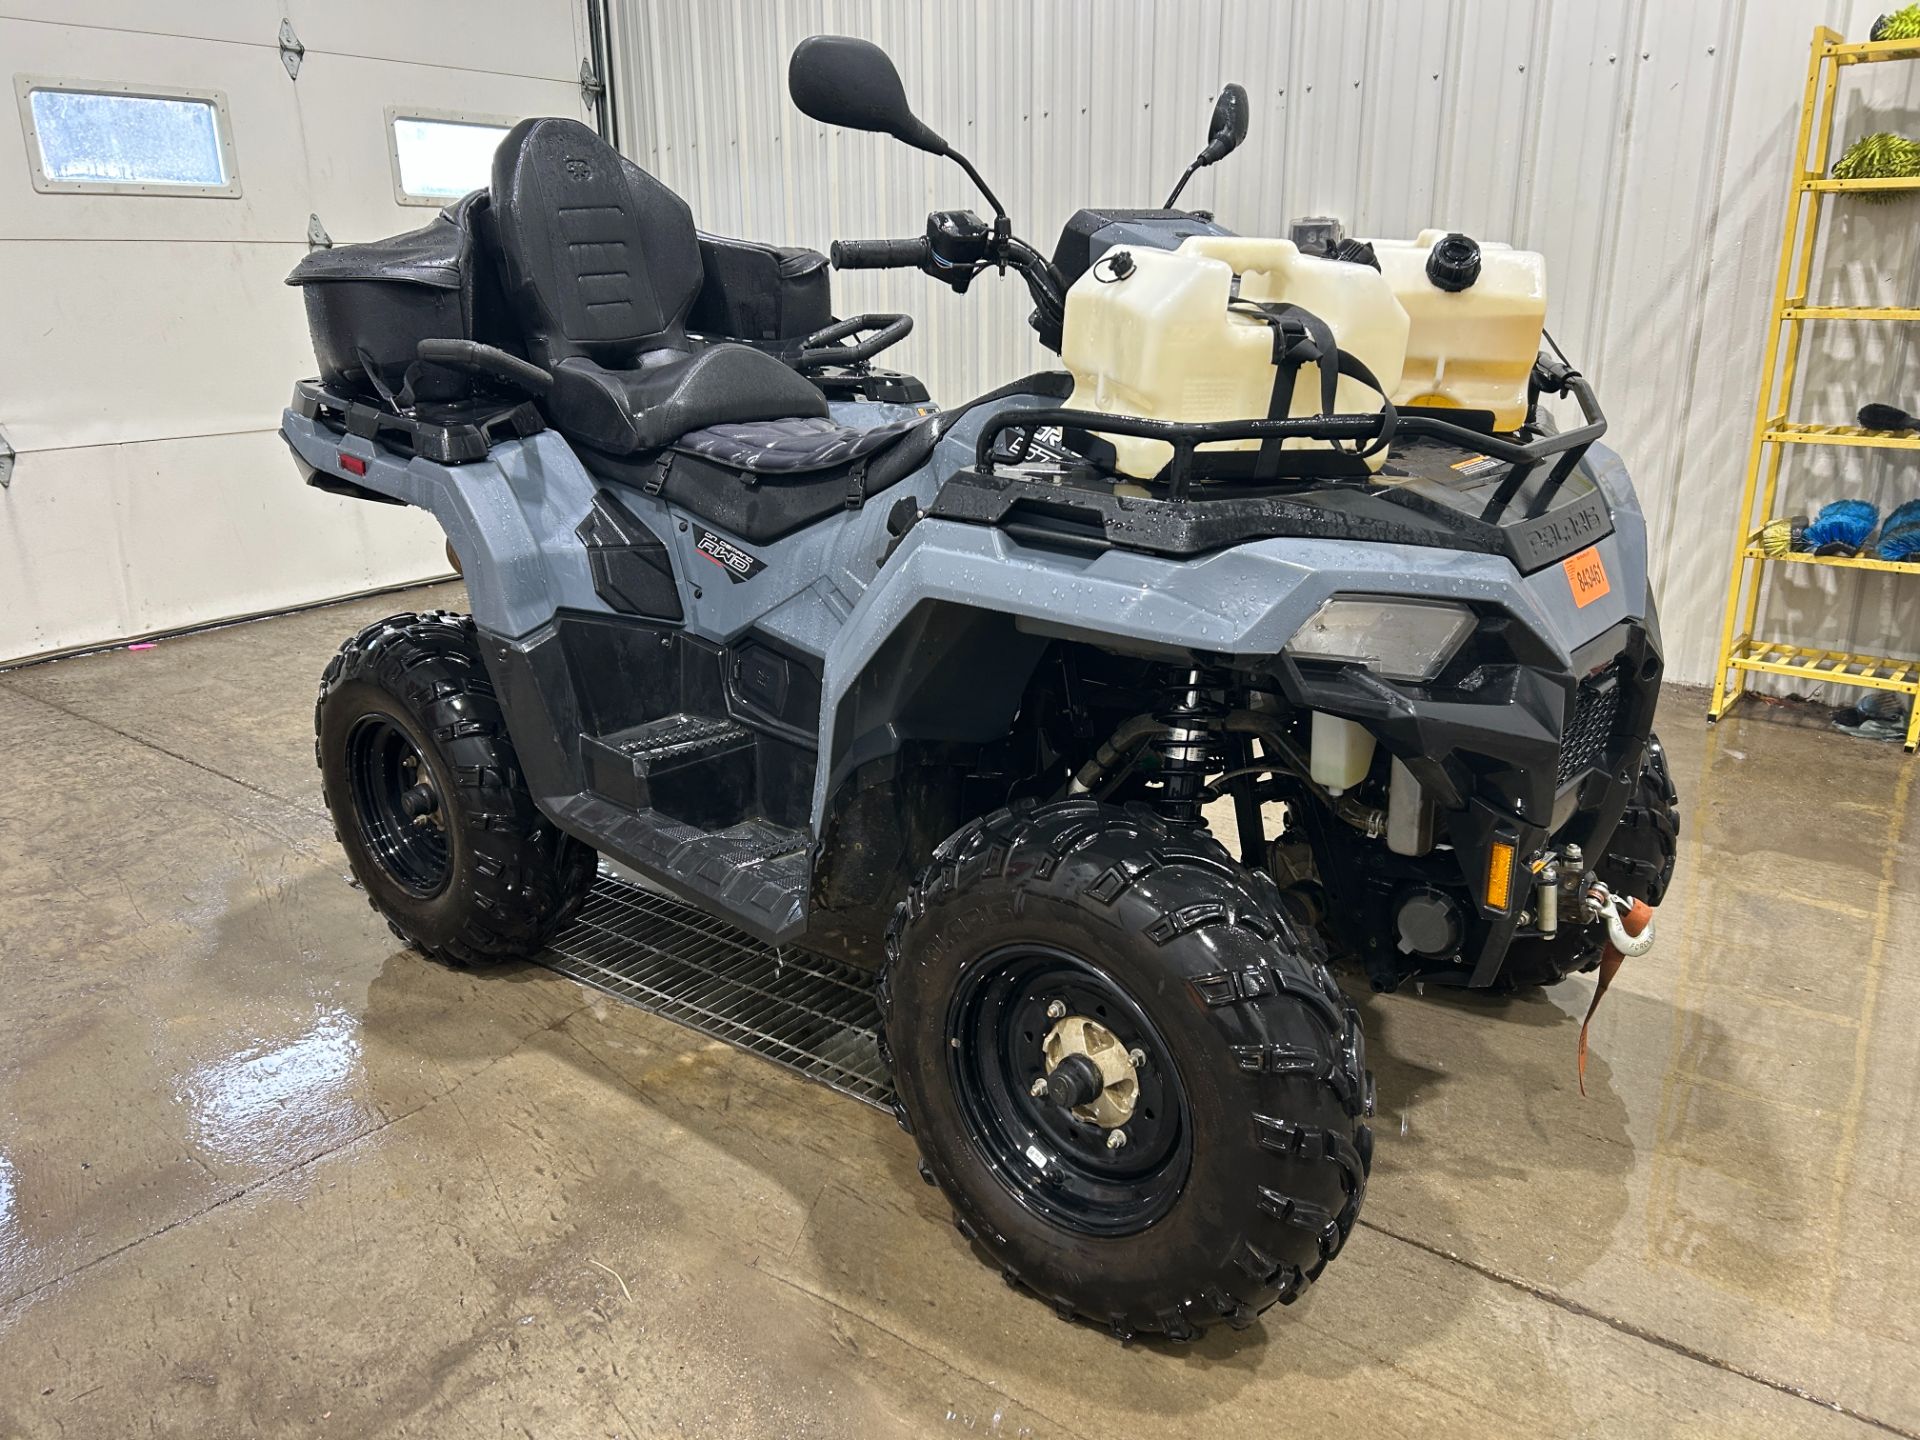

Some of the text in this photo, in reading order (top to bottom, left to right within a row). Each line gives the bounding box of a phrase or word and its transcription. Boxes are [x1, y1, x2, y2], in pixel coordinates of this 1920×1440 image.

[1526, 505, 1601, 556] POLARIS
[697, 537, 750, 573] AWD
[1576, 561, 1605, 593] 843461
